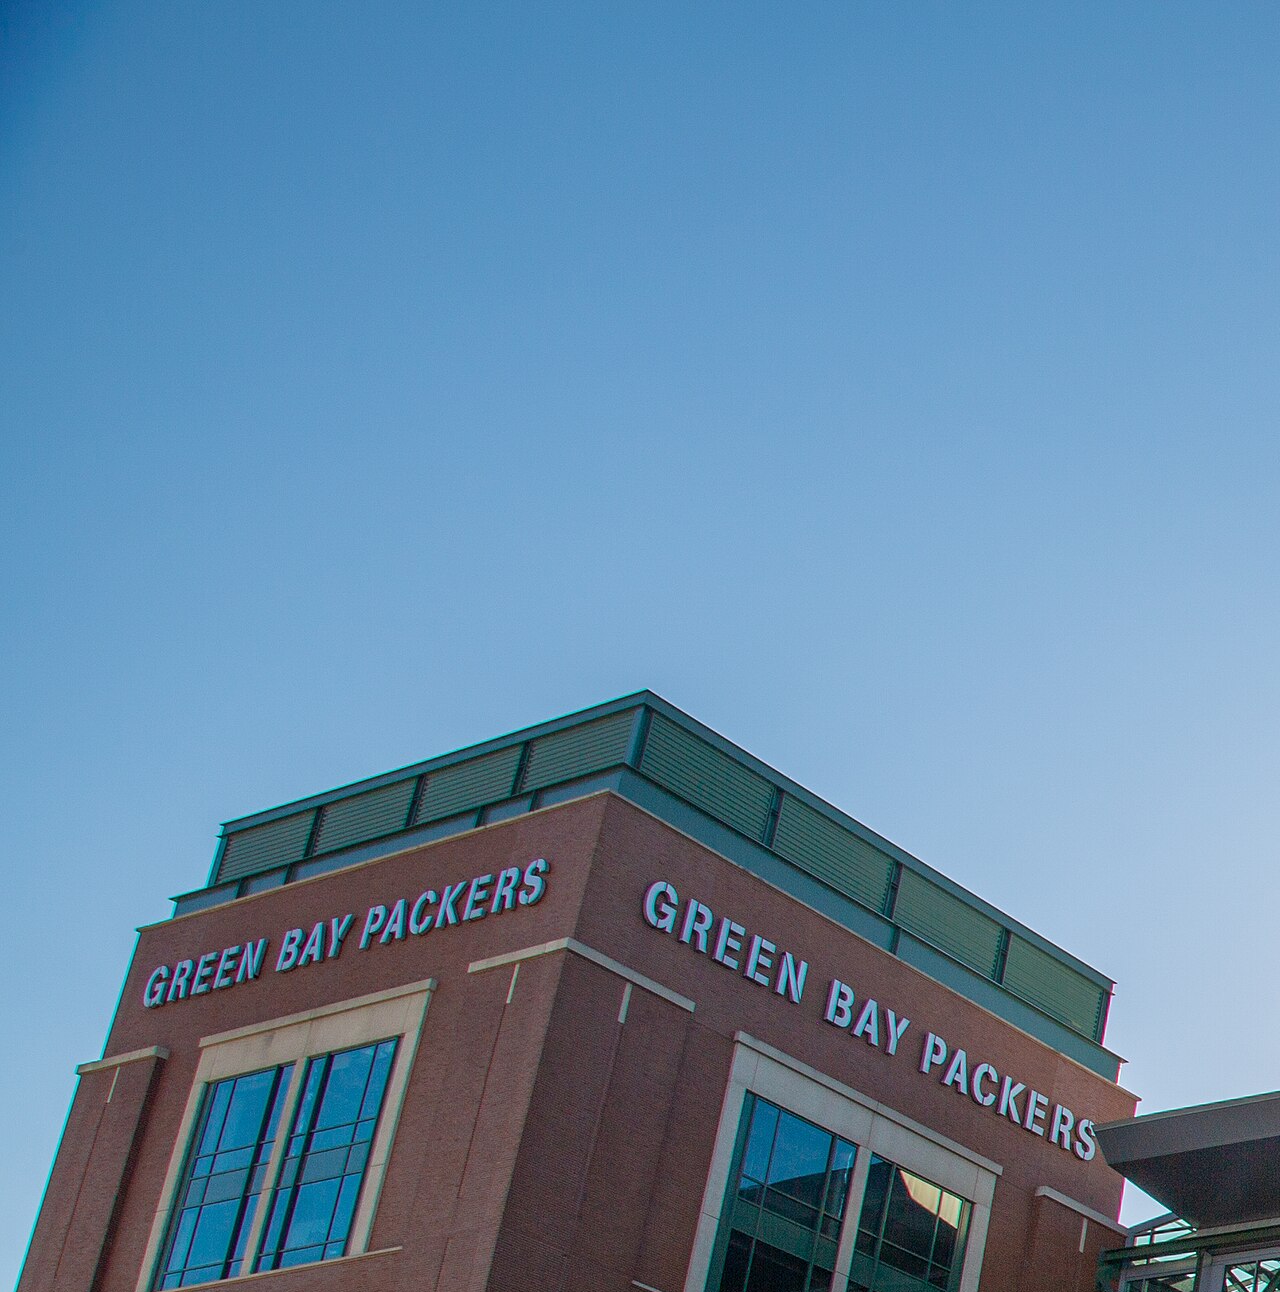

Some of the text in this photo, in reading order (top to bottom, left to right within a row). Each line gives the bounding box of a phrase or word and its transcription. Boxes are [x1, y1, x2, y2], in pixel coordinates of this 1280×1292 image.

[143, 858, 550, 1009] GREEN BAY PACKERS
[642, 880, 1098, 1162] GREEN BAY PACKERS
